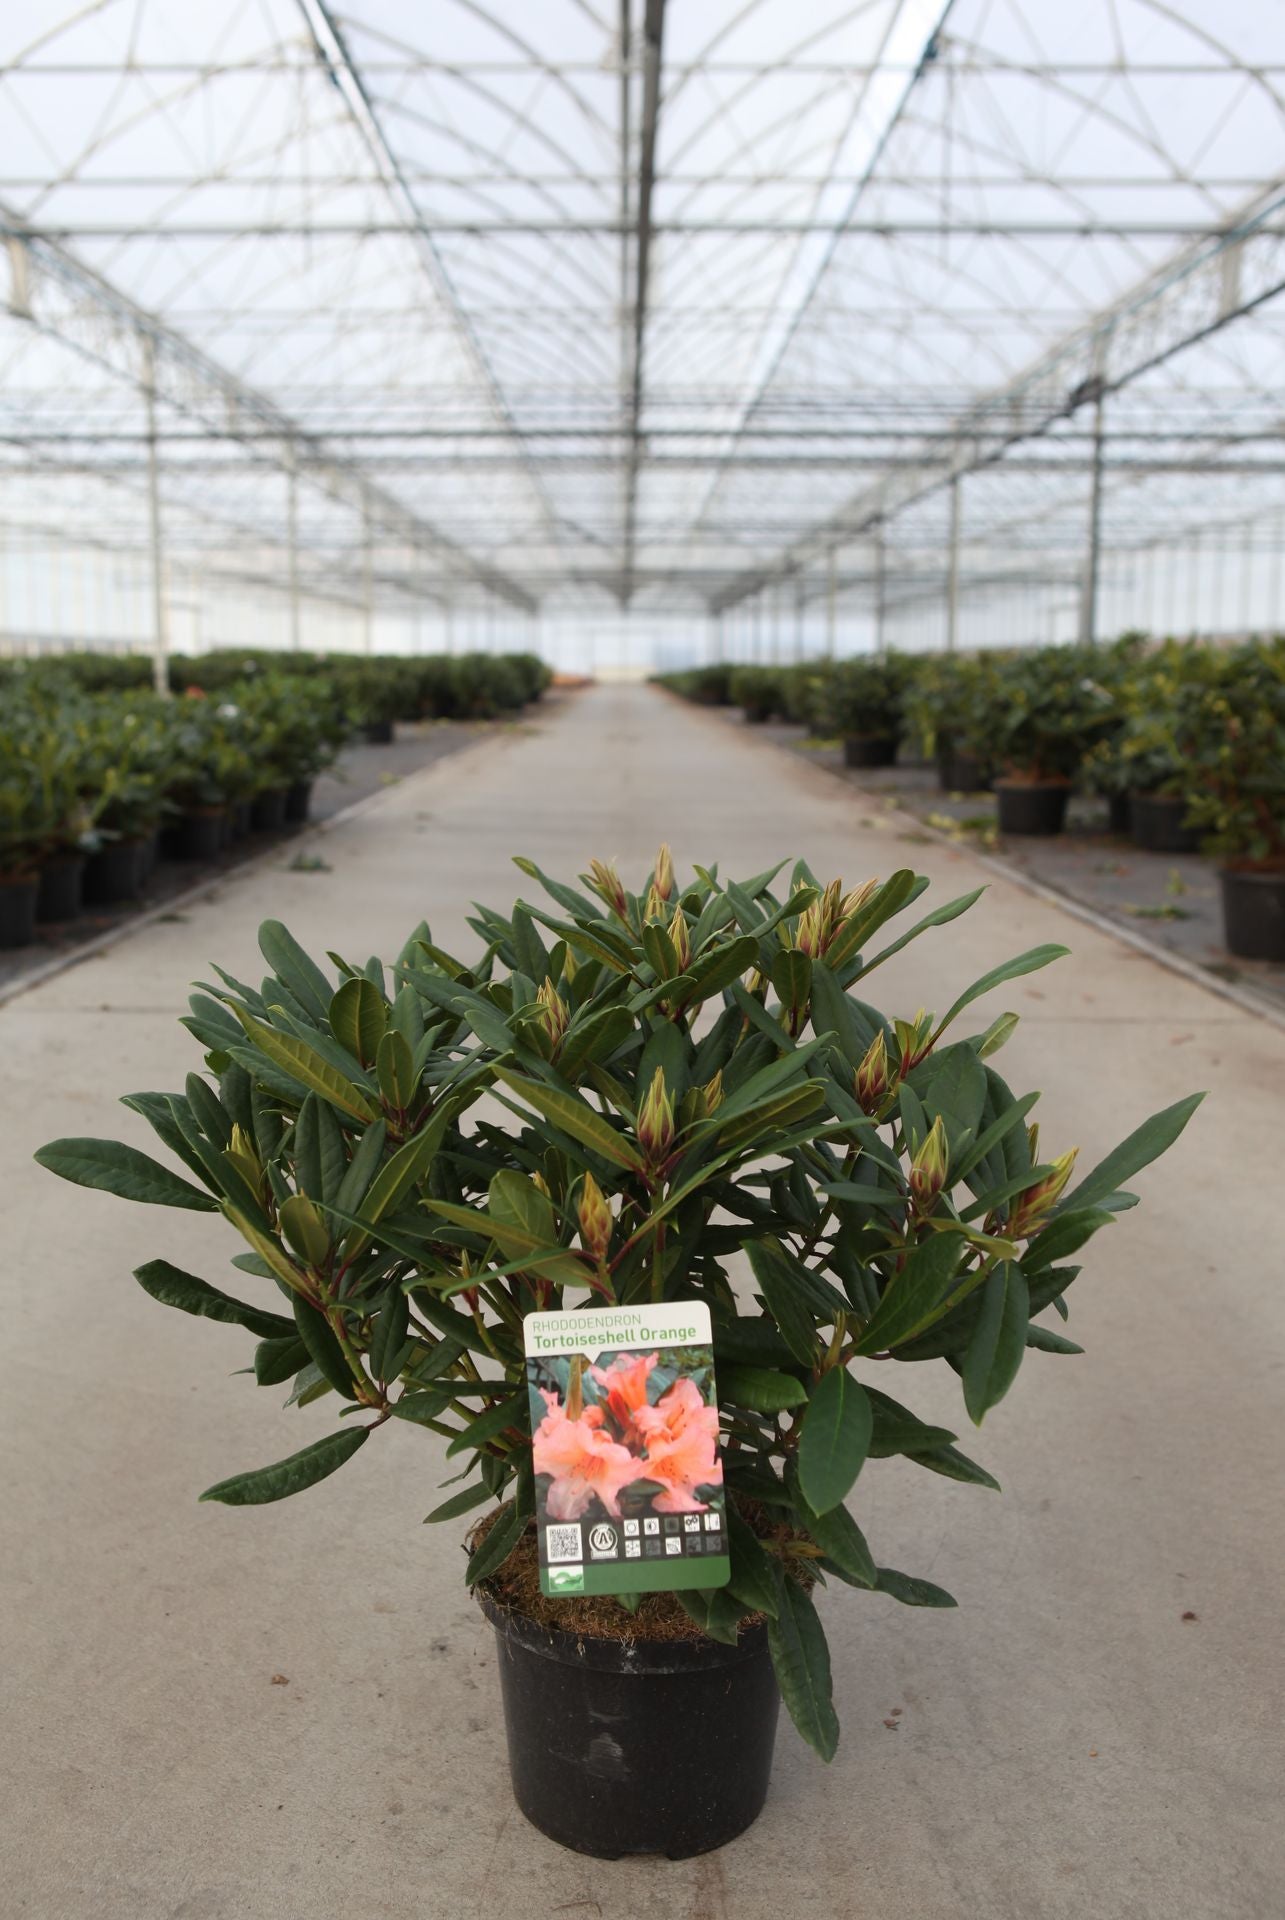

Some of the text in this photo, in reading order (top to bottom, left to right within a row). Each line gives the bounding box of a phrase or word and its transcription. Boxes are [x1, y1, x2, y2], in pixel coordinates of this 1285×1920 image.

[533, 1314, 641, 1332] RHODODENDRON
[534, 1327, 696, 1349] Tortoiseshell Orange
